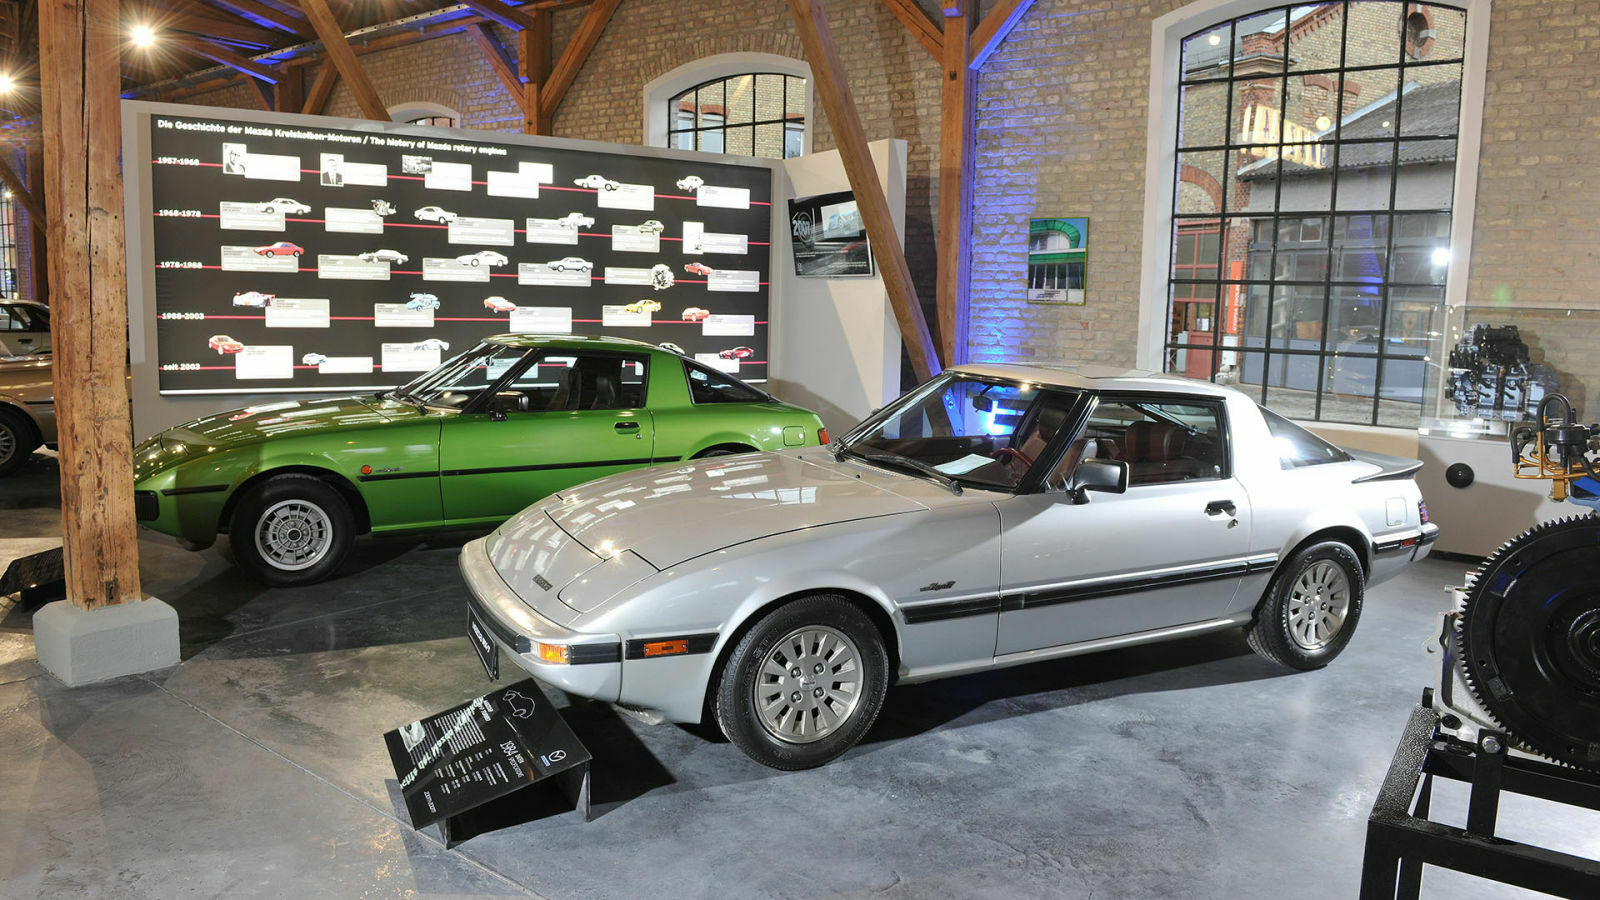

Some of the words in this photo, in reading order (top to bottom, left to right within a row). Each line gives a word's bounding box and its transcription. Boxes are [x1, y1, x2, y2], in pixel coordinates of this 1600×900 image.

[157, 119, 173, 129] Die
[175, 121, 226, 134] Geschichte
[227, 125, 242, 134] der
[244, 127, 274, 137] Mazda
[369, 136, 385, 146] The
[387, 138, 415, 149] history
[416, 139, 426, 149] of
[427, 141, 452, 151] Mazda
[453, 144, 477, 155] rotary
[478, 147, 507, 156] engines
[158, 209, 202, 218] 1968-1978
[160, 261, 203, 269] 1978-1988
[161, 312, 205, 320] 1988-2003
[163, 363, 179, 371] seit
[180, 363, 201, 371] 2003
[500, 740, 518, 757] 1984
